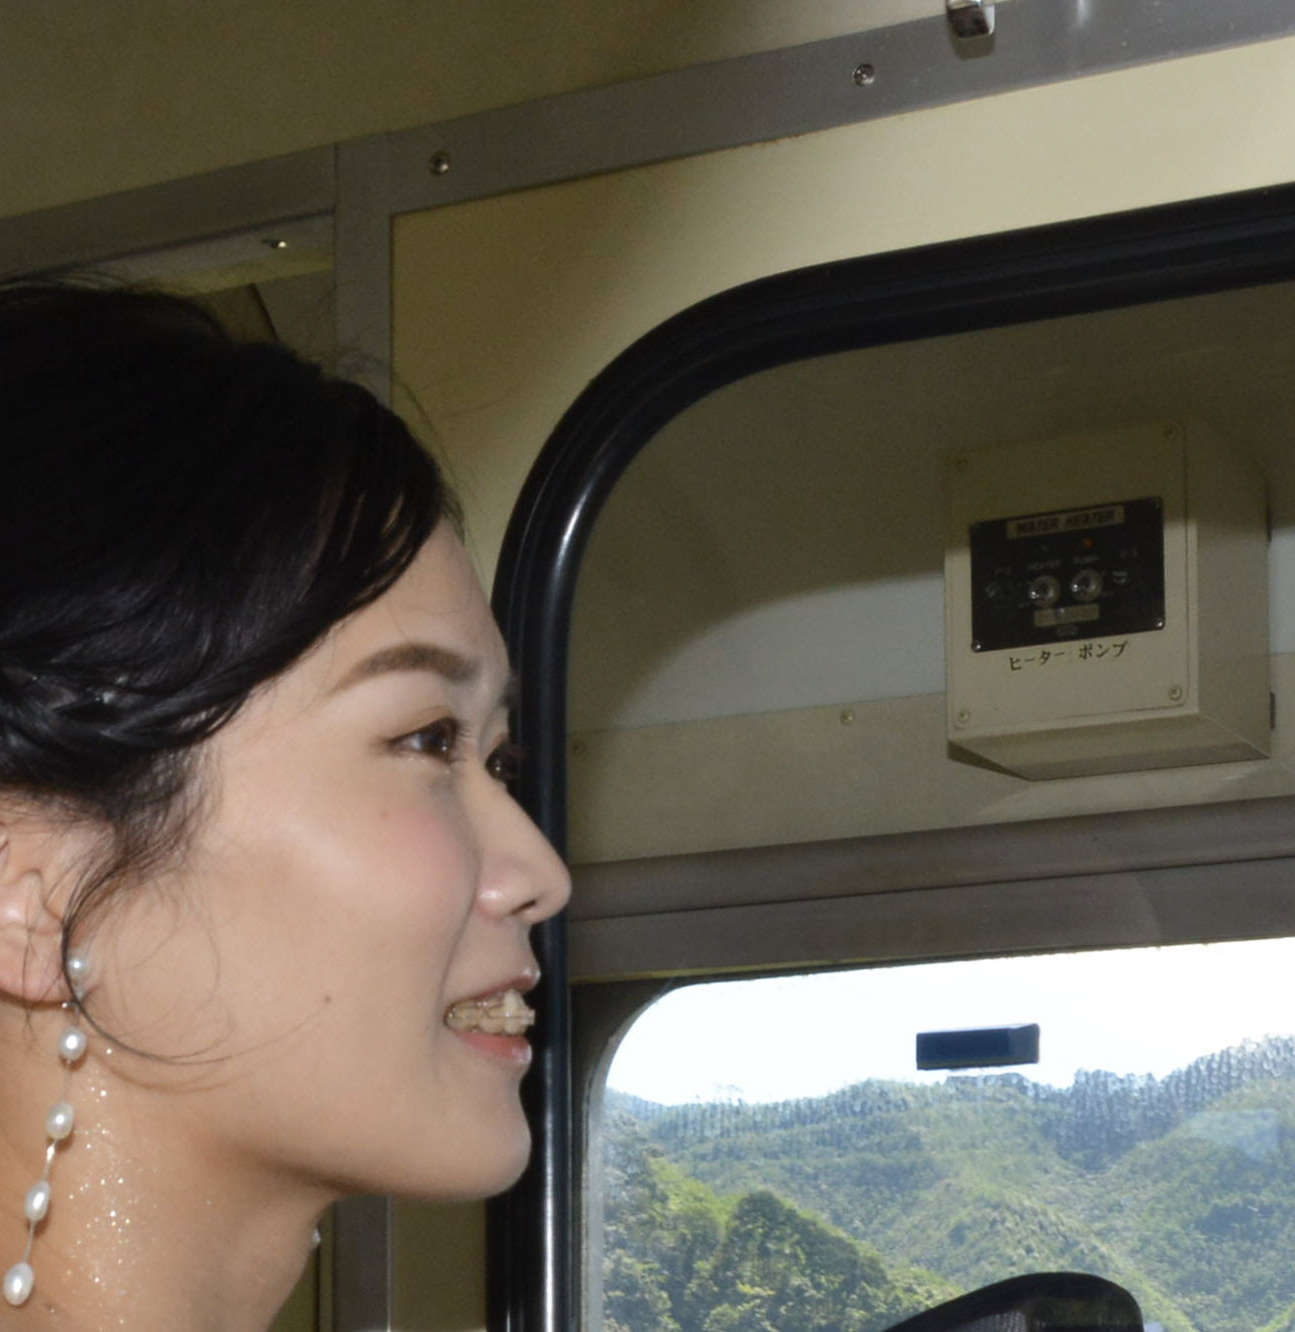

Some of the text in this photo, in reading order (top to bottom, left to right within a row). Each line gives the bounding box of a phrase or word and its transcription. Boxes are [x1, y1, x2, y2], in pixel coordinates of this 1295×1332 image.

[1008, 640, 1129, 672] ヒーター ポンプ
